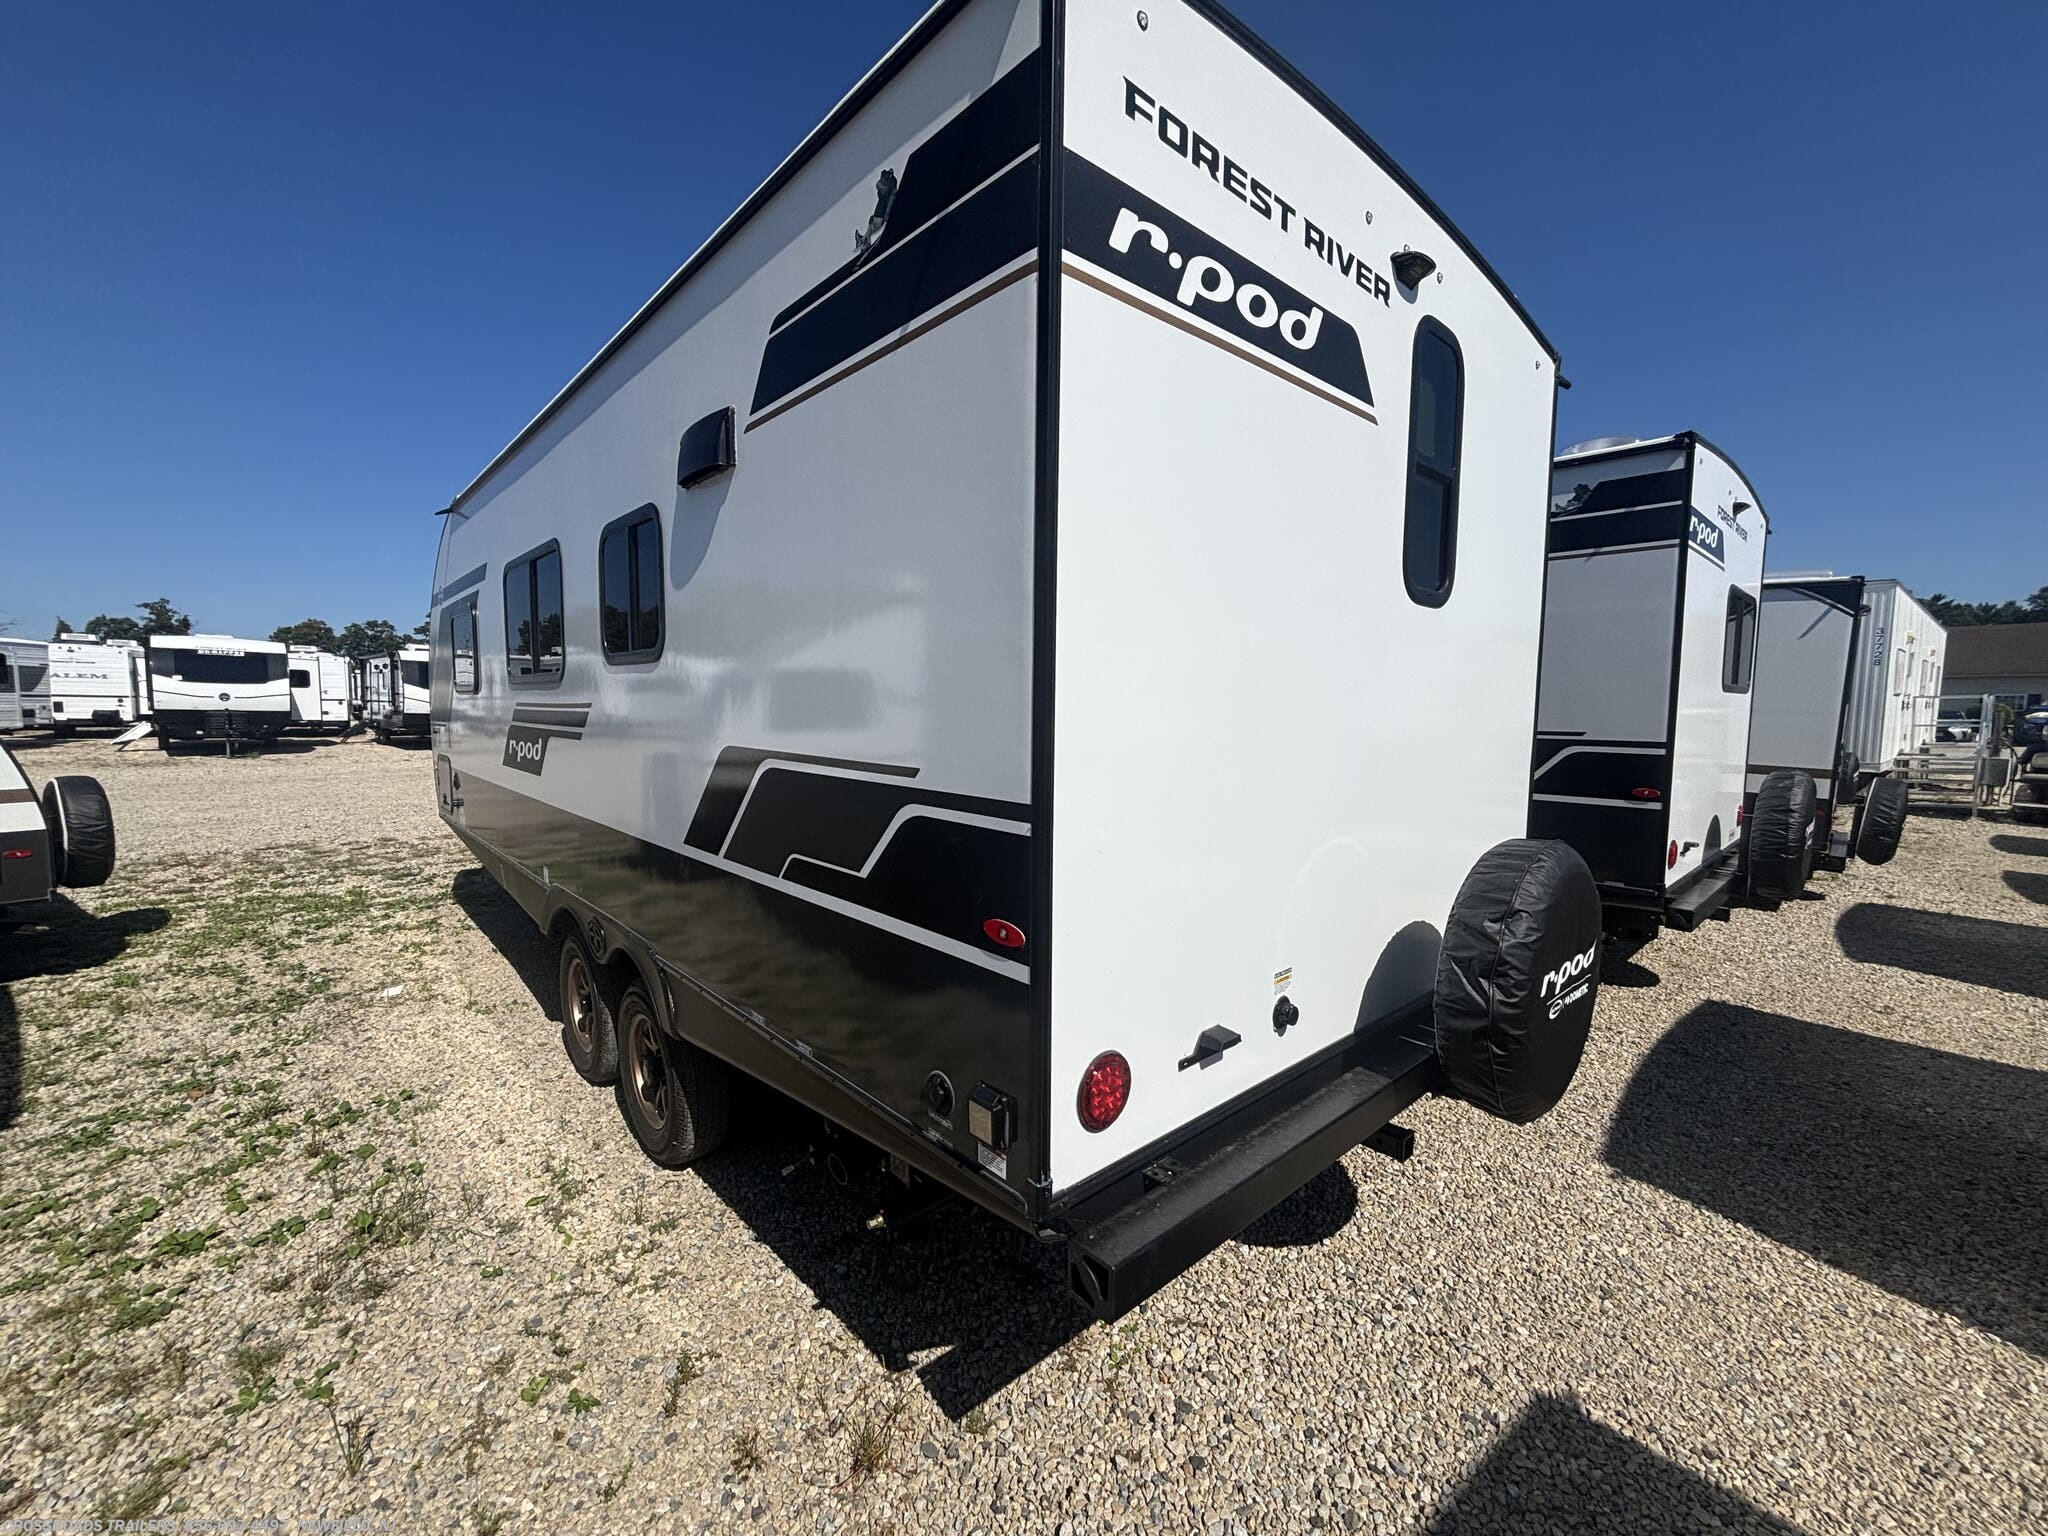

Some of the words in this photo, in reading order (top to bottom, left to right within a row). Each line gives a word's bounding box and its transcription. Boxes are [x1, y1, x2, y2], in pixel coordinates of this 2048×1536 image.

[1122, 75, 1297, 233] FOREST
[1303, 216, 1391, 308] RIVER
[1873, 627, 1884, 666] 37728
[50, 672, 109, 680] ALEM
